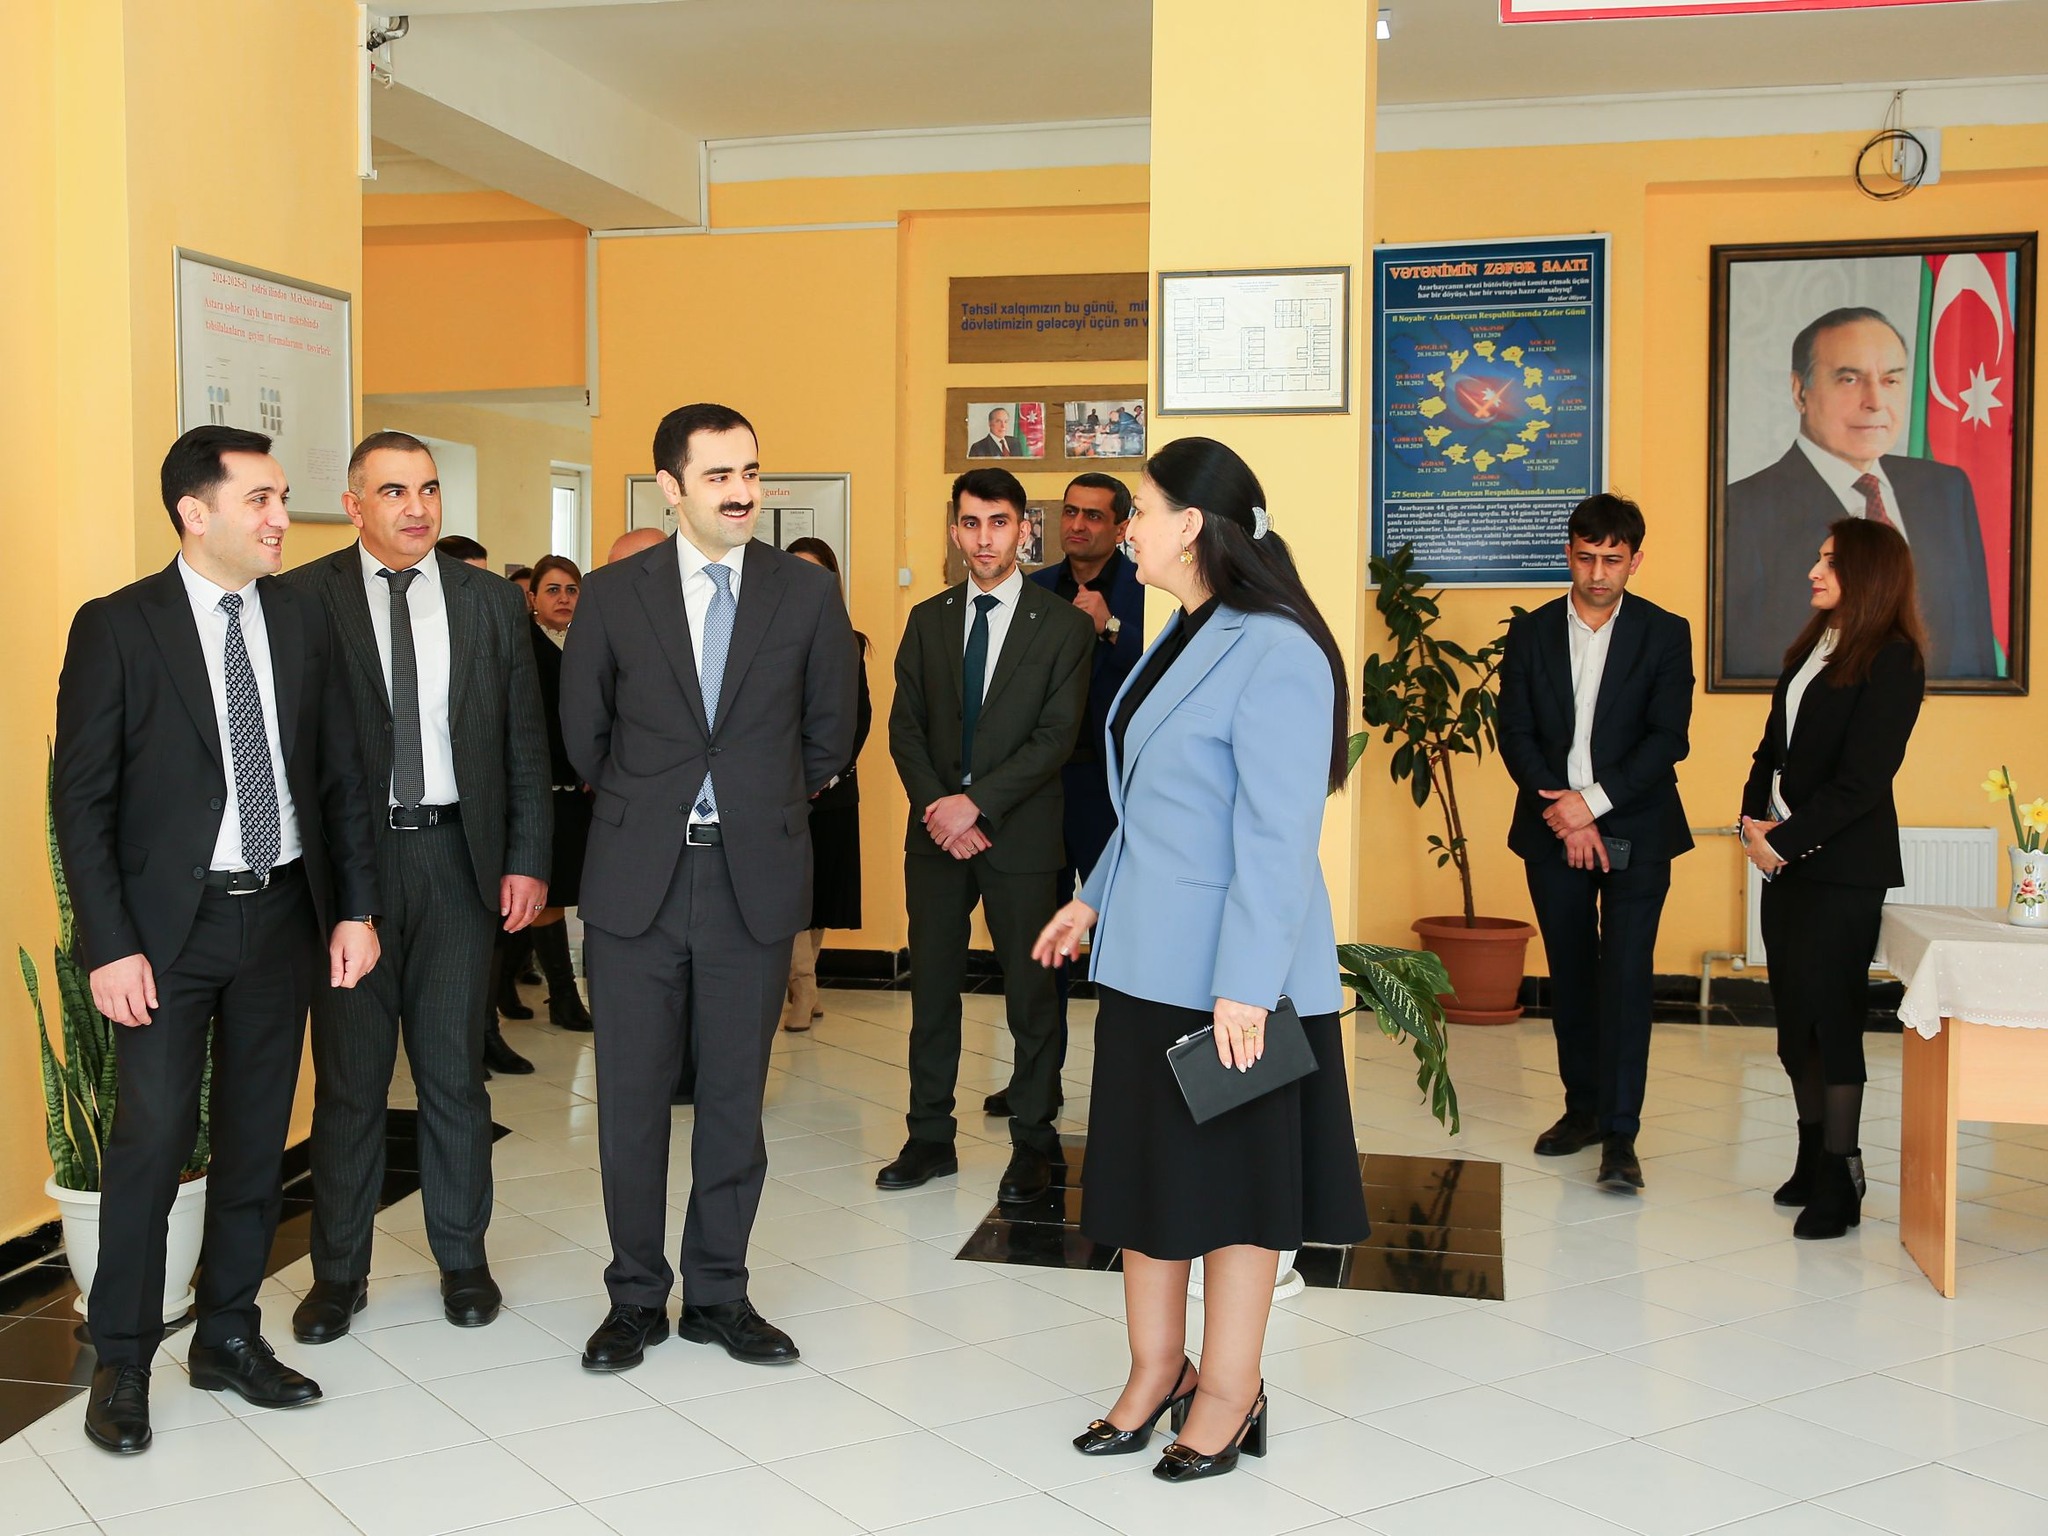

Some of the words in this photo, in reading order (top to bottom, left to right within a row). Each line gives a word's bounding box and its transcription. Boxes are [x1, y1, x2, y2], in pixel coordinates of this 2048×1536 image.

[1389, 262, 1478, 280] VƏTƏNİMİN
[1483, 261, 1537, 275] ZƏFƏR
[1542, 259, 1588, 273] SAATI
[1483, 288, 1492, 296] bir
[962, 303, 997, 315] Təhsil
[1001, 302, 1061, 317] xalqımızın
[1065, 302, 1079, 313] bu
[1084, 301, 1118, 318] günü,
[961, 318, 1033, 331] dövlətimizin
[1037, 317, 1086, 332] gələcəyi
[1090, 316, 1119, 331] üçün
[1124, 317, 1138, 327] ən
[1399, 314, 1426, 324] Noyabr
[1402, 491, 1434, 499] Sentyabr
[1441, 490, 1483, 498] Azərbaycan
[1567, 487, 1586, 495] Günü
